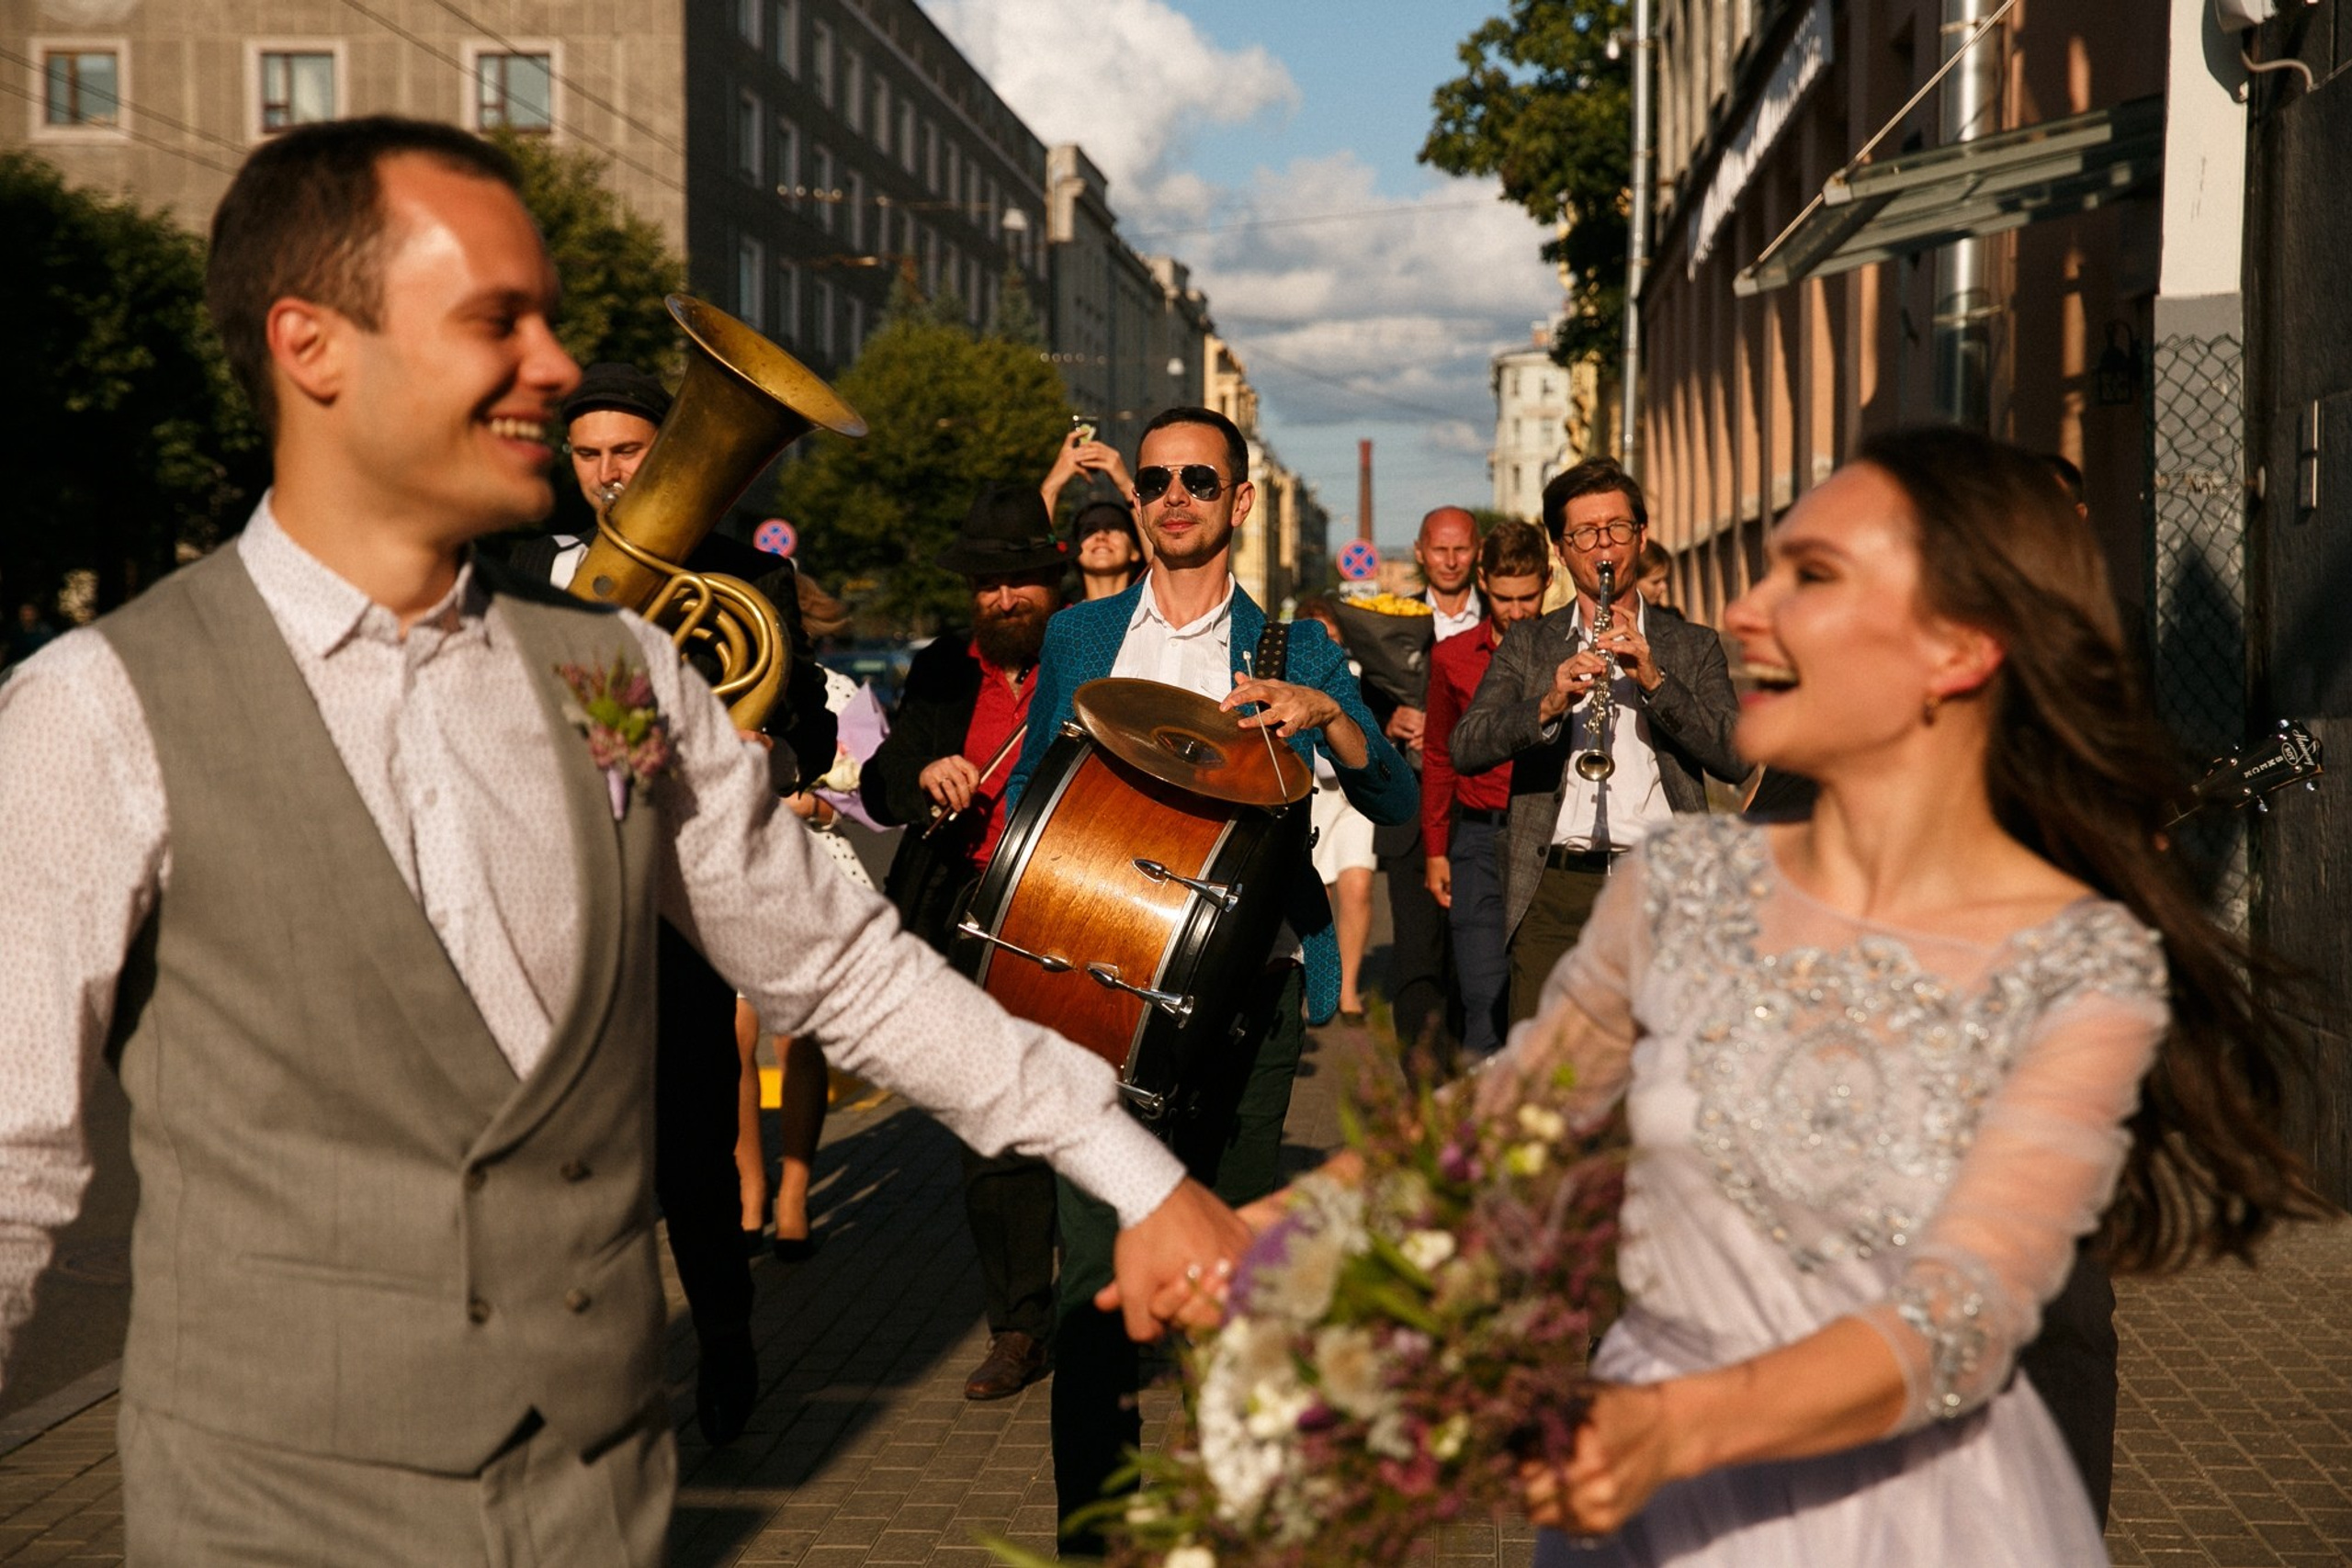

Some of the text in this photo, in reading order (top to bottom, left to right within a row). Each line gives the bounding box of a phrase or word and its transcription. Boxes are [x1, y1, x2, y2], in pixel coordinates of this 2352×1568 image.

[2284, 747, 2295, 761] ROY
[2292, 729, 2315, 765] Harmony
[2244, 755, 2283, 778] SMECK
